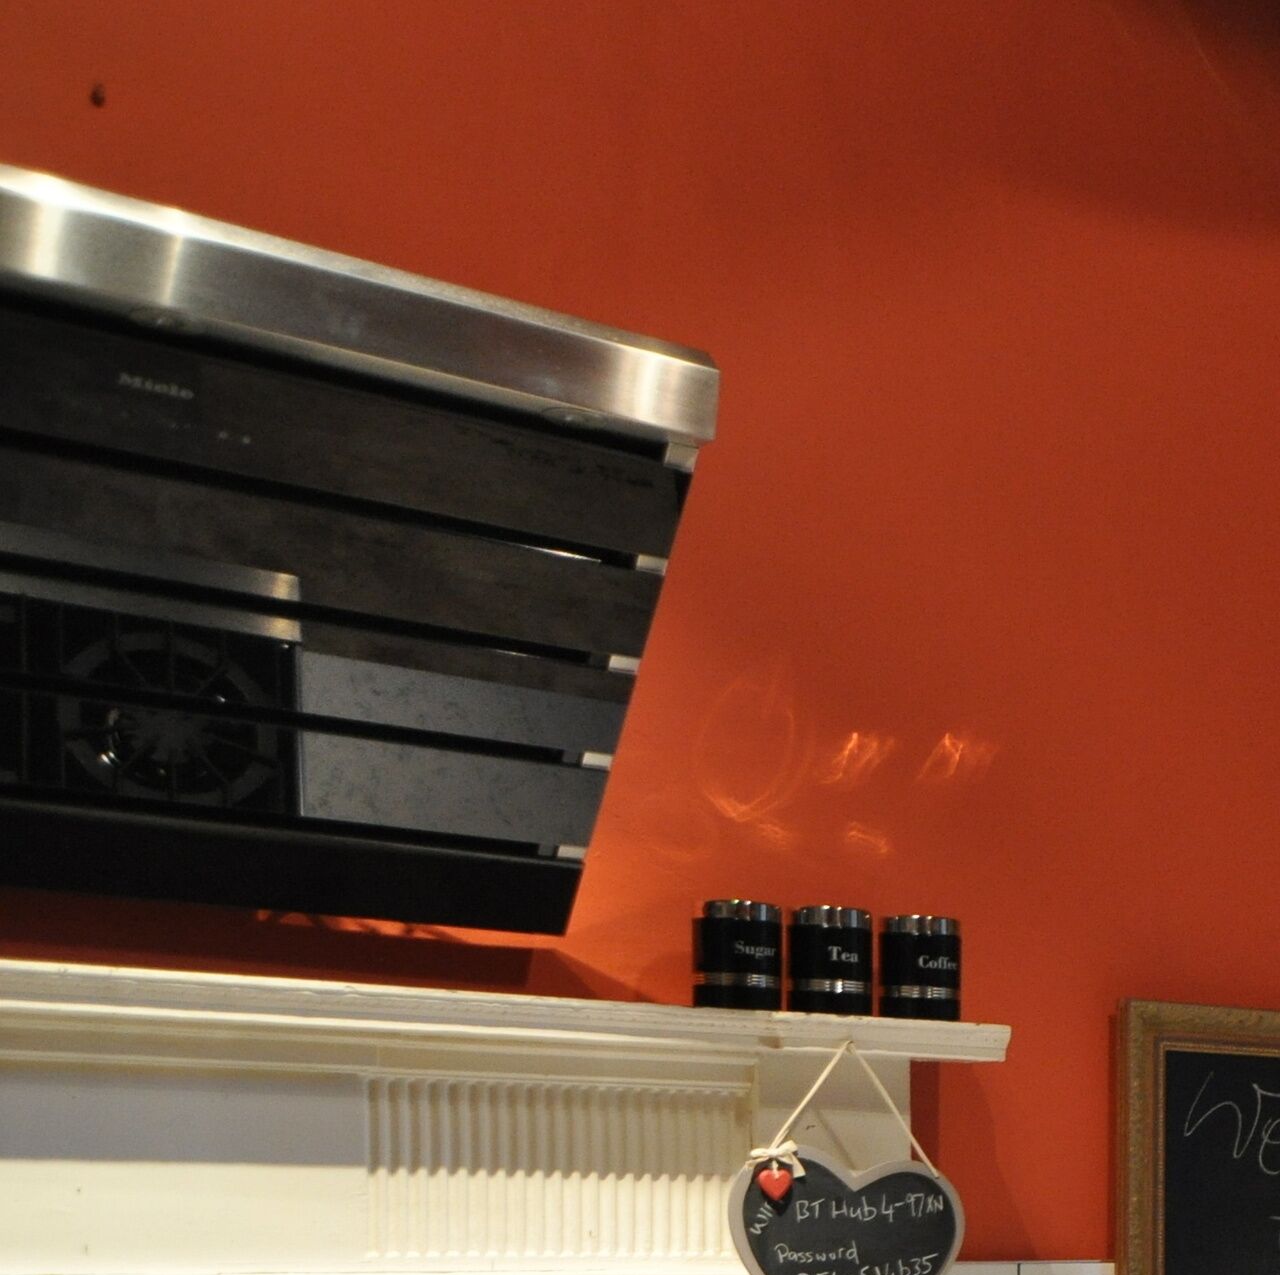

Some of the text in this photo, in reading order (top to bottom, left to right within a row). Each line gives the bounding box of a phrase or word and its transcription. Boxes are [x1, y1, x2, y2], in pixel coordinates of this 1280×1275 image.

[734, 940, 776, 960] Sugar
[828, 946, 858, 963] Tea
[795, 1198, 825, 1223] BT
[774, 1240, 859, 1265] Password
